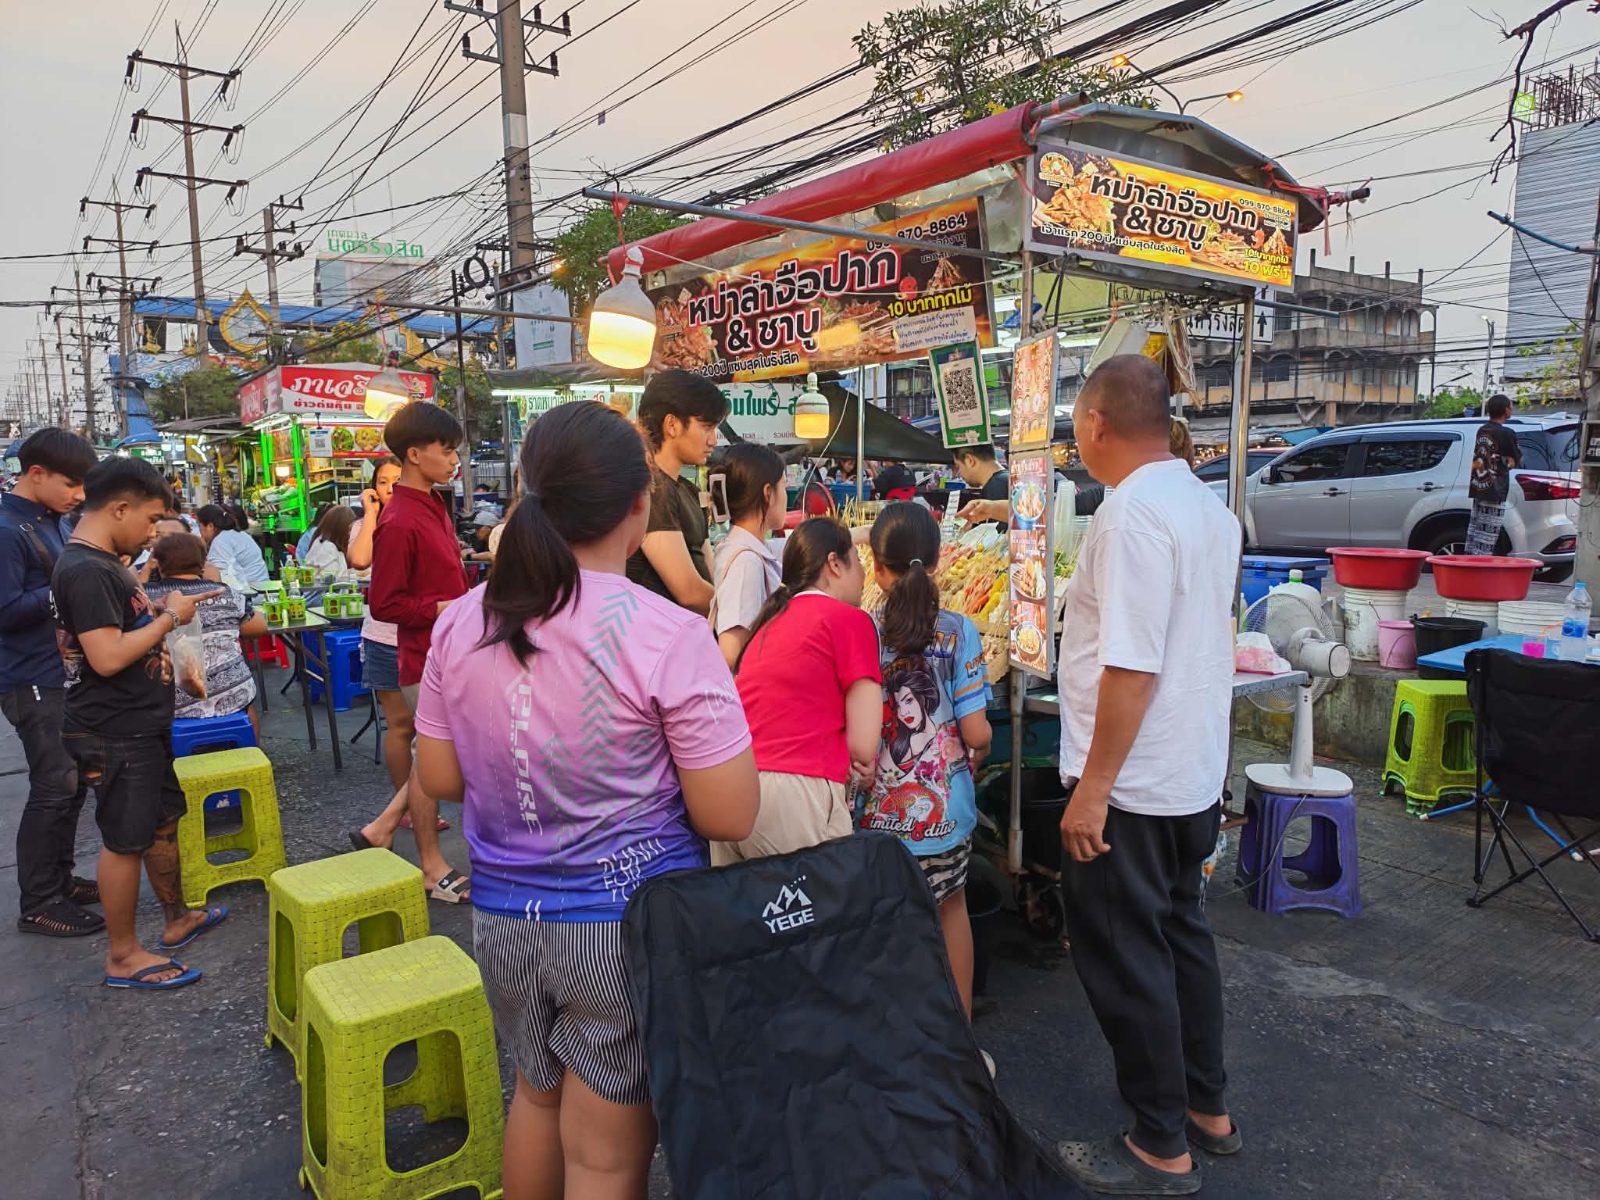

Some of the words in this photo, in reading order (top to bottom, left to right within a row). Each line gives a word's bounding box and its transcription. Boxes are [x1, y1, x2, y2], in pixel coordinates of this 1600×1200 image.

[1091, 174, 1257, 228] หม่าล่าจือปาก
[1126, 206, 1150, 232] &
[1156, 215, 1207, 250] ชาบู
[689, 249, 898, 325] หม่าล่าจือปาก
[1243, 259, 1260, 273] 10
[727, 317, 752, 352] &
[759, 309, 821, 351] ชาบู
[887, 301, 904, 318] 10
[764, 907, 816, 934] YEGE
